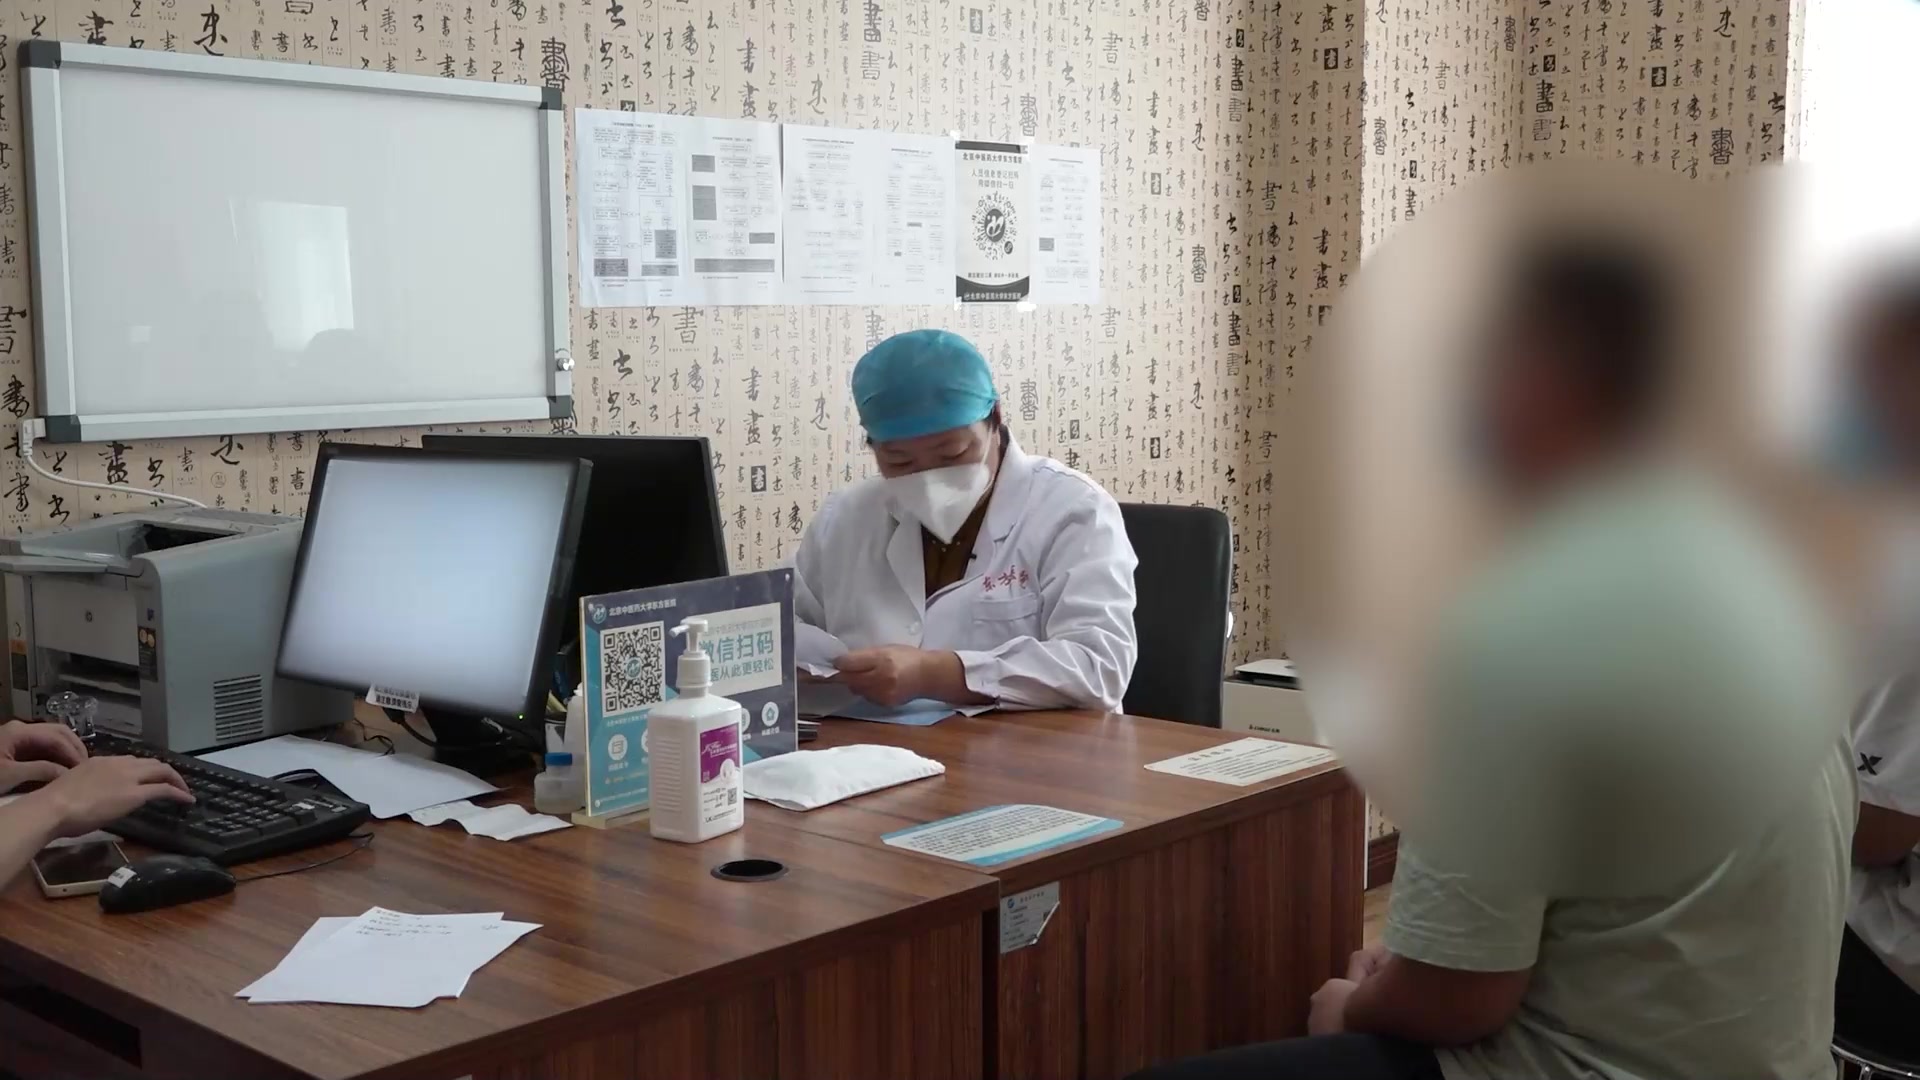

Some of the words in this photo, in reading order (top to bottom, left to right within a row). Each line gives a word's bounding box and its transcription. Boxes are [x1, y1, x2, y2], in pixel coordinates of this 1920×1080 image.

[609, 598, 677, 616] 北京中医药大学东方医院
[711, 658, 774, 681] 医从此更轻松
